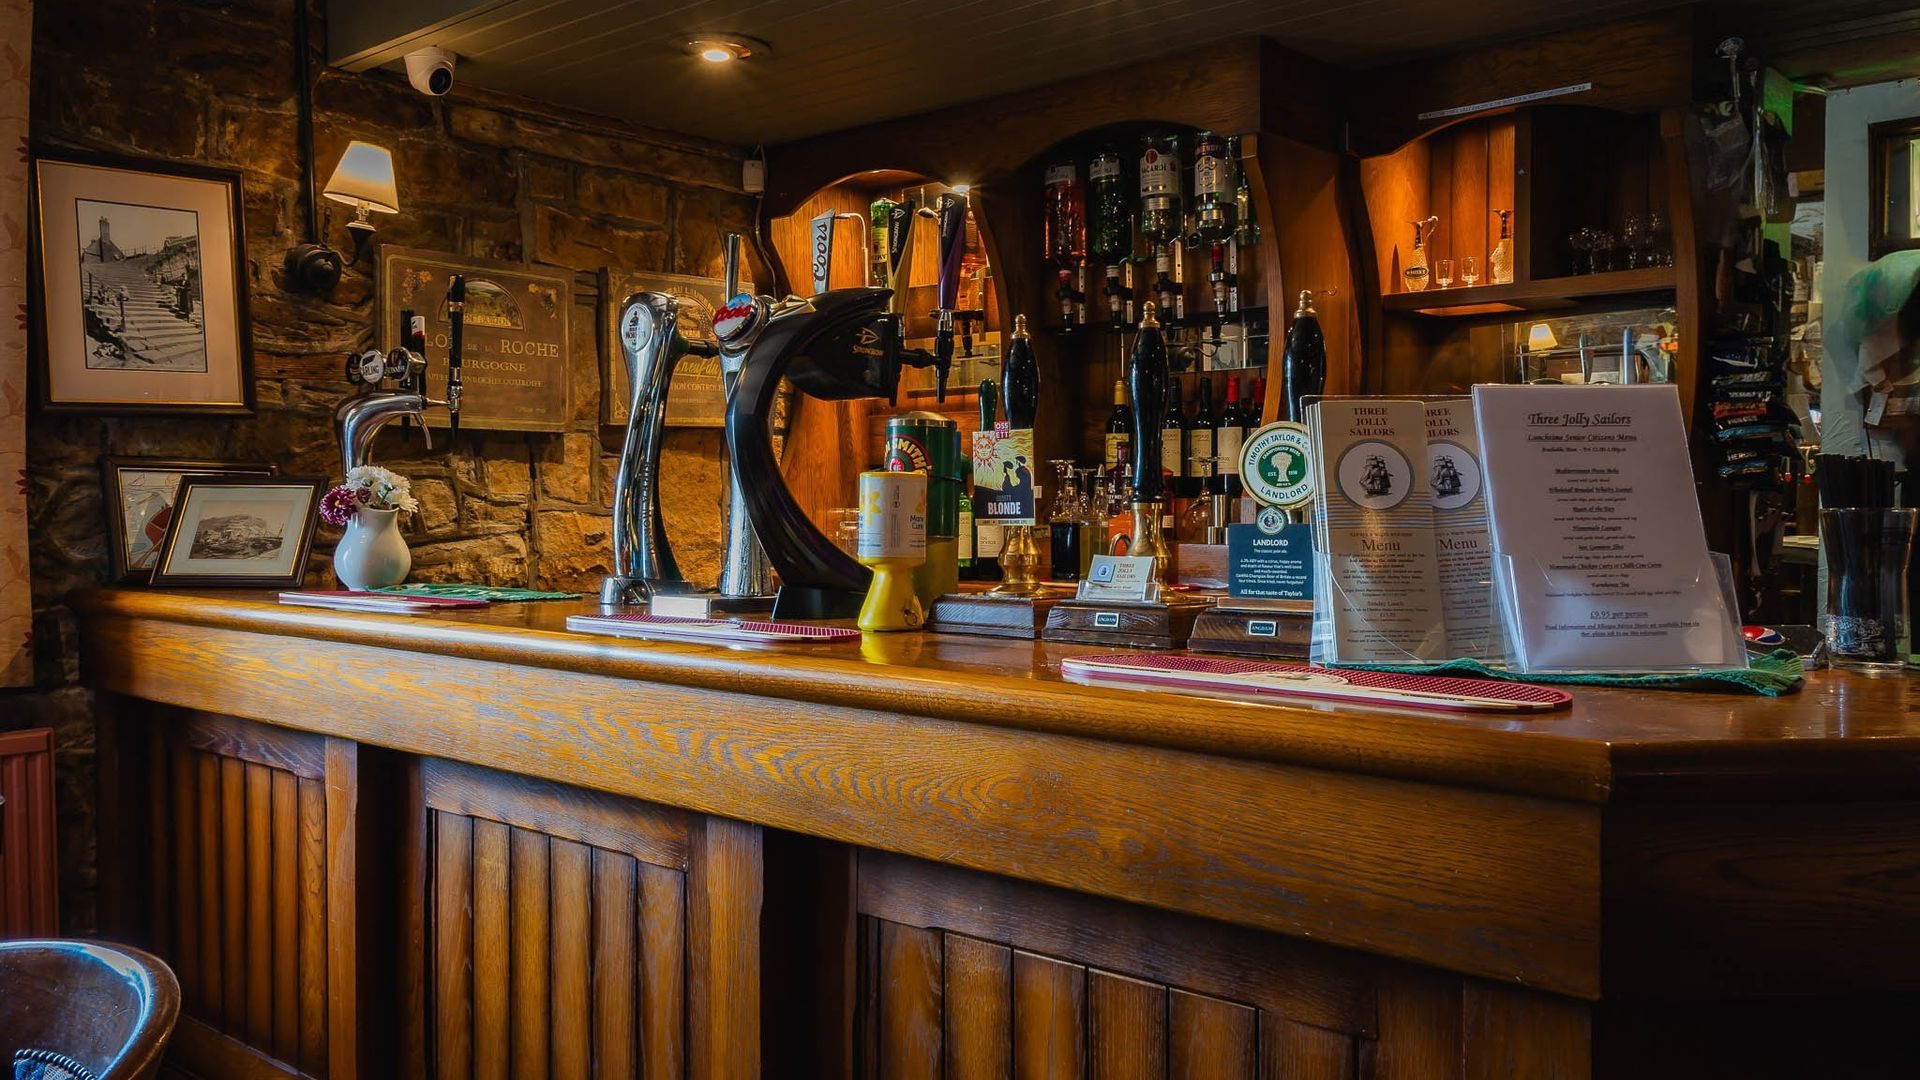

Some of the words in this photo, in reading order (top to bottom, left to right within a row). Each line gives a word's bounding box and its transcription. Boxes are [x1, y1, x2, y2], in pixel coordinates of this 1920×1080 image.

[813, 221, 828, 282] Coors
[501, 339, 559, 358] ROCHE
[1353, 407, 1388, 415] THREE
[1355, 418, 1388, 426] JOLLY
[1425, 418, 1451, 427] OLLY
[1528, 412, 1559, 426] Three
[1562, 412, 1590, 428] Jolly
[1592, 412, 1632, 426] Sailors
[1350, 428, 1395, 437] SAILORS
[1248, 436, 1271, 466] TIMOTHY
[1270, 433, 1296, 443] TAYLOR
[1260, 484, 1309, 500] LANDLORD
[988, 501, 1021, 515] BLONDE
[1361, 539, 1401, 552] Menu
[1440, 538, 1478, 551] Menu
